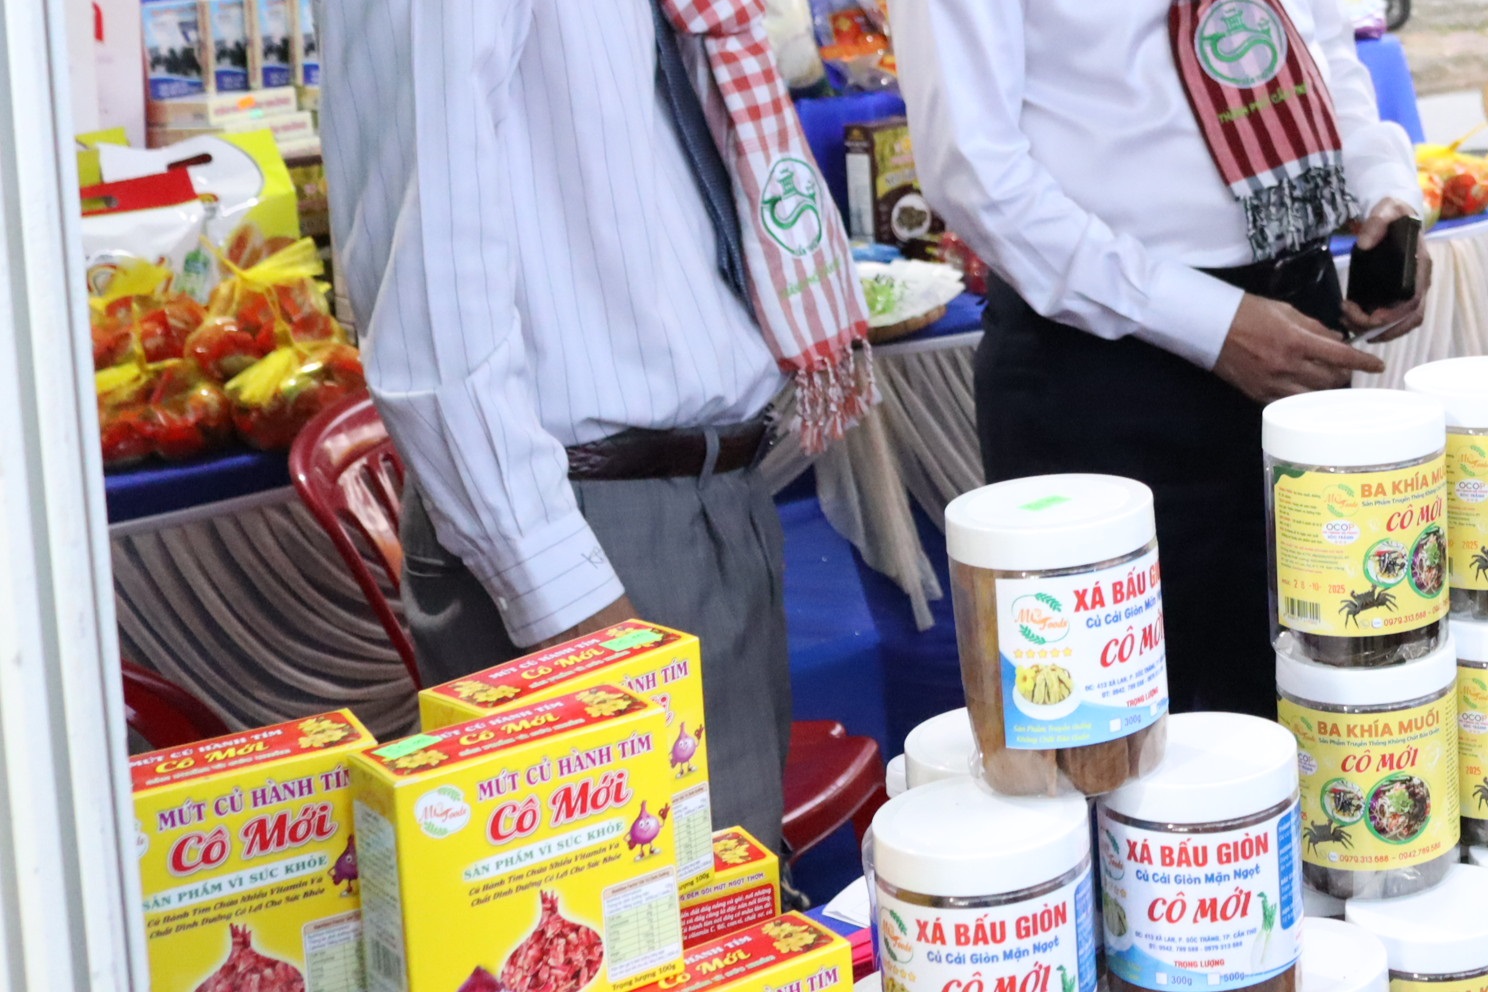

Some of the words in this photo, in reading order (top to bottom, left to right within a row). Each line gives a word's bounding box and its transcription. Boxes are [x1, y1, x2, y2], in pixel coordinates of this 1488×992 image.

[1360, 483, 1387, 498] BA
[1392, 472, 1429, 495] KHÍA
[1458, 481, 1486, 490] OCOP
[1326, 522, 1355, 532] OCOP
[1386, 504, 1413, 532] CÔ
[1416, 495, 1442, 528] MỚI
[1074, 581, 1106, 612] XÁ
[1112, 566, 1146, 605] BẤU
[1328, 584, 1346, 594] 2025
[1086, 617, 1101, 629] Củ
[1100, 626, 1135, 668] CÔ
[521, 666, 552, 680] Cô
[554, 648, 604, 668] Mới
[660, 658, 689, 683] TÍM
[459, 730, 496, 746] Cô
[501, 712, 560, 734] Mới
[1317, 720, 1341, 737] BA
[1346, 719, 1393, 738] KHÍA
[1398, 709, 1440, 735] MUỐI
[1462, 713, 1487, 721] OCOP
[155, 759, 195, 774] Cô
[205, 741, 272, 762] Mới
[477, 771, 518, 801] MỨT
[526, 760, 552, 785] CỦ
[558, 745, 612, 774] HÀNH
[618, 731, 652, 758] TÍM
[1341, 749, 1372, 773] CÔ
[1376, 744, 1418, 772] MỚI
[158, 797, 206, 832] MỨT
[214, 786, 244, 818] CỦ
[251, 779, 313, 808] HÀNH
[489, 793, 540, 842] Cô
[551, 771, 630, 824] Mới
[171, 829, 229, 873] Cô
[243, 804, 337, 857] Mới
[464, 861, 490, 880] SẢN
[496, 849, 535, 871] PHẨM
[557, 835, 583, 851] SỨC
[587, 821, 624, 842] KHỎE
[1126, 838, 1153, 866] XÁ
[1160, 838, 1208, 868] BẤU
[1217, 832, 1269, 865] GIÒN
[142, 896, 171, 911] SẢN
[178, 881, 222, 903] PHẨM
[250, 867, 279, 884] SỨC
[284, 854, 328, 875] KHỎE
[695, 872, 710, 885] 100g
[1135, 869, 1150, 883] Củ
[1152, 870, 1170, 884] Cải
[1174, 872, 1201, 885] Giòn
[1205, 872, 1230, 886] Mặn
[1233, 863, 1261, 880] Ngọt
[1148, 891, 1187, 924] CÔ
[1193, 886, 1252, 924] MỚI
[916, 917, 947, 946] XÁ
[954, 913, 1006, 946] BẤU
[1015, 901, 1067, 940] GIÒN
[696, 950, 751, 975] Mới
[926, 950, 943, 963] Củ
[946, 952, 966, 965] Cải
[970, 952, 999, 964] Giòn
[1003, 947, 1030, 963] Mặn
[1032, 935, 1059, 953] Ngọt
[1174, 960, 1198, 969] TRỌNG
[1200, 959, 1225, 968] LƯỢNG
[658, 962, 677, 975] 100g
[1171, 976, 1192, 986] 300g
[1223, 972, 1245, 982] 500g
